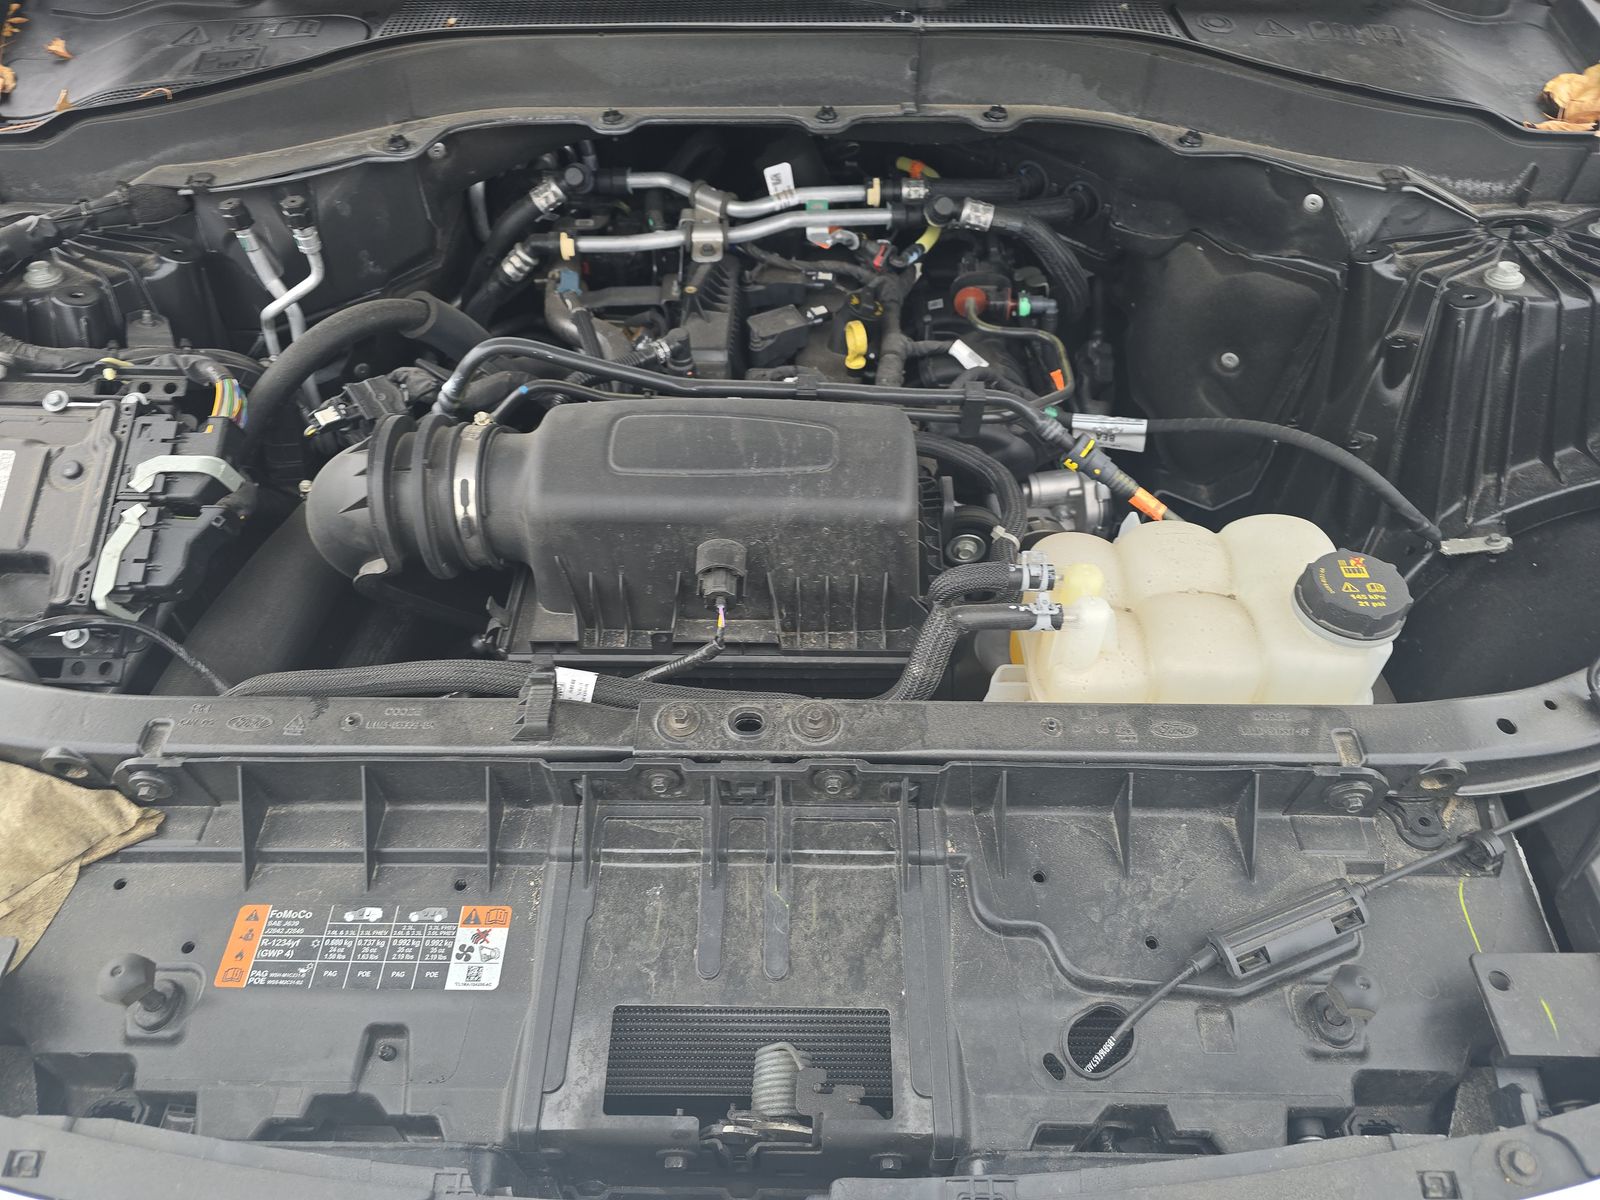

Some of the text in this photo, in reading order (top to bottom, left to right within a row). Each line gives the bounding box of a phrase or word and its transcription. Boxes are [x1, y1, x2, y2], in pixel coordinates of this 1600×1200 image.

[270, 909, 313, 919] FoMoCo
[260, 938, 302, 949] R-1234yf
[344, 939, 353, 948] kg
[376, 939, 386, 948] kg
[411, 939, 421, 948] kg
[444, 939, 454, 948] kg
[257, 949, 294, 959] (GWP 4)
